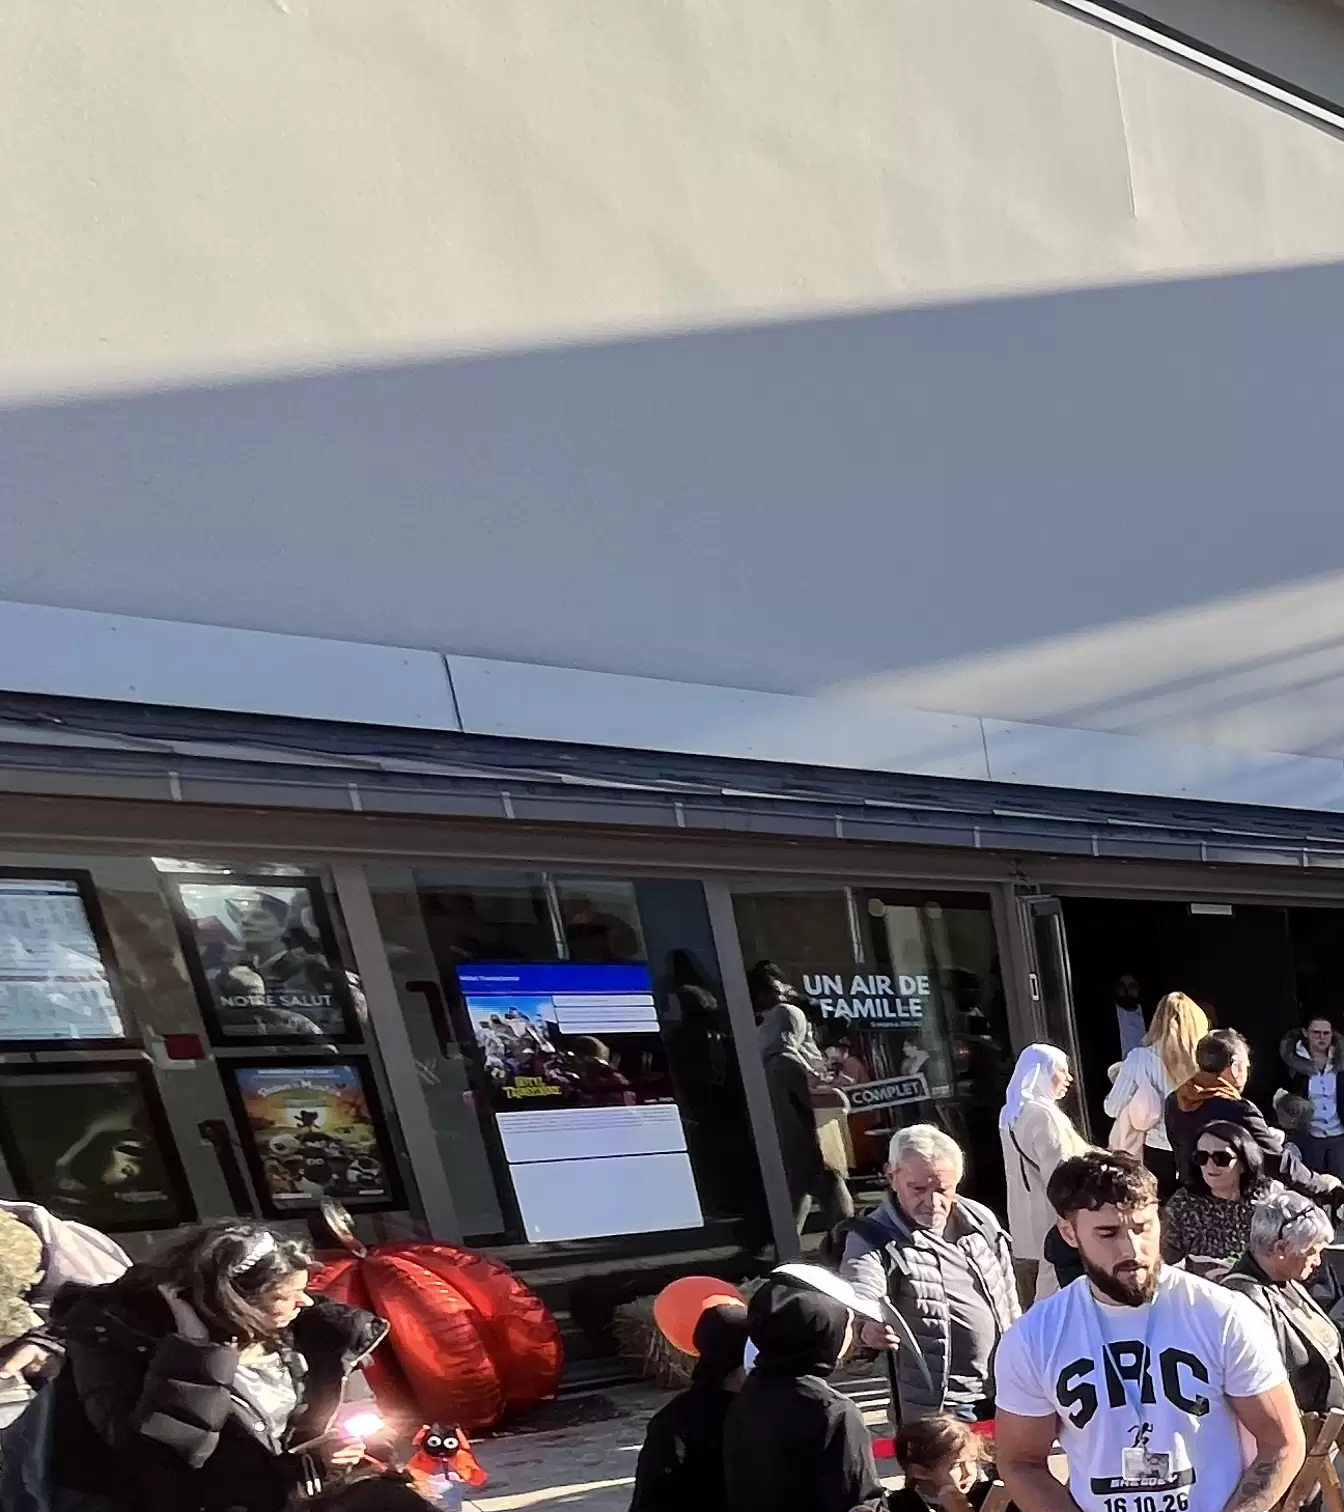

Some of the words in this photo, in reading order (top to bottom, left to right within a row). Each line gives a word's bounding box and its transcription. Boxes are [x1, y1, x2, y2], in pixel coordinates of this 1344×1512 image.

[803, 975, 843, 995] UN
[850, 975, 894, 995] AIR
[899, 975, 930, 995] DE
[220, 995, 278, 1007] NOTRE
[279, 995, 331, 1007] SALUT
[820, 999, 923, 1018] FAMILLE
[852, 1082, 919, 1104] COMPLET
[1056, 1341, 1210, 1429] SRC
